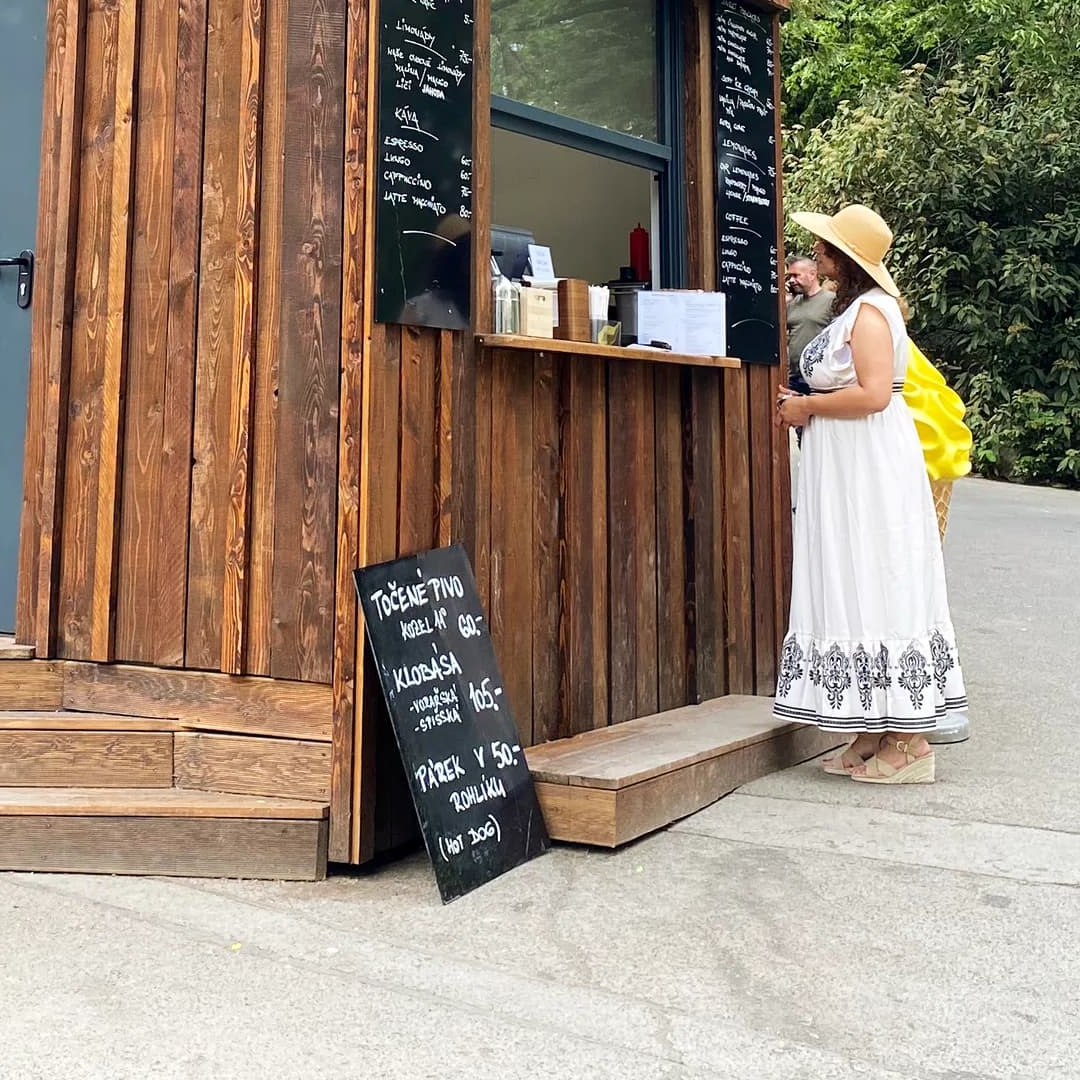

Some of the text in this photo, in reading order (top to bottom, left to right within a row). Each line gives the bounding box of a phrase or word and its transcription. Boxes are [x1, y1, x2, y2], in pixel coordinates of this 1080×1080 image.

[396, 18, 436, 48] LIMONÁDY
[395, 105, 420, 130] KÁVA
[384, 136, 424, 153] ESPRESSO
[384, 152, 411, 167] LUNGO
[384, 171, 432, 190] CAPPUCCINO
[384, 191, 408, 206] LATTE
[370, 568, 464, 621] TOČENÉ PIVO
[400, 617, 434, 640] KOZEL
[392, 642, 462, 692] KLOBÁSA
[415, 754, 466, 792] PÁREK
[473, 746, 485, 768] V
[449, 774, 506, 812] ROHLÍKU
[438, 814, 500, 862] (HOT DOG)
